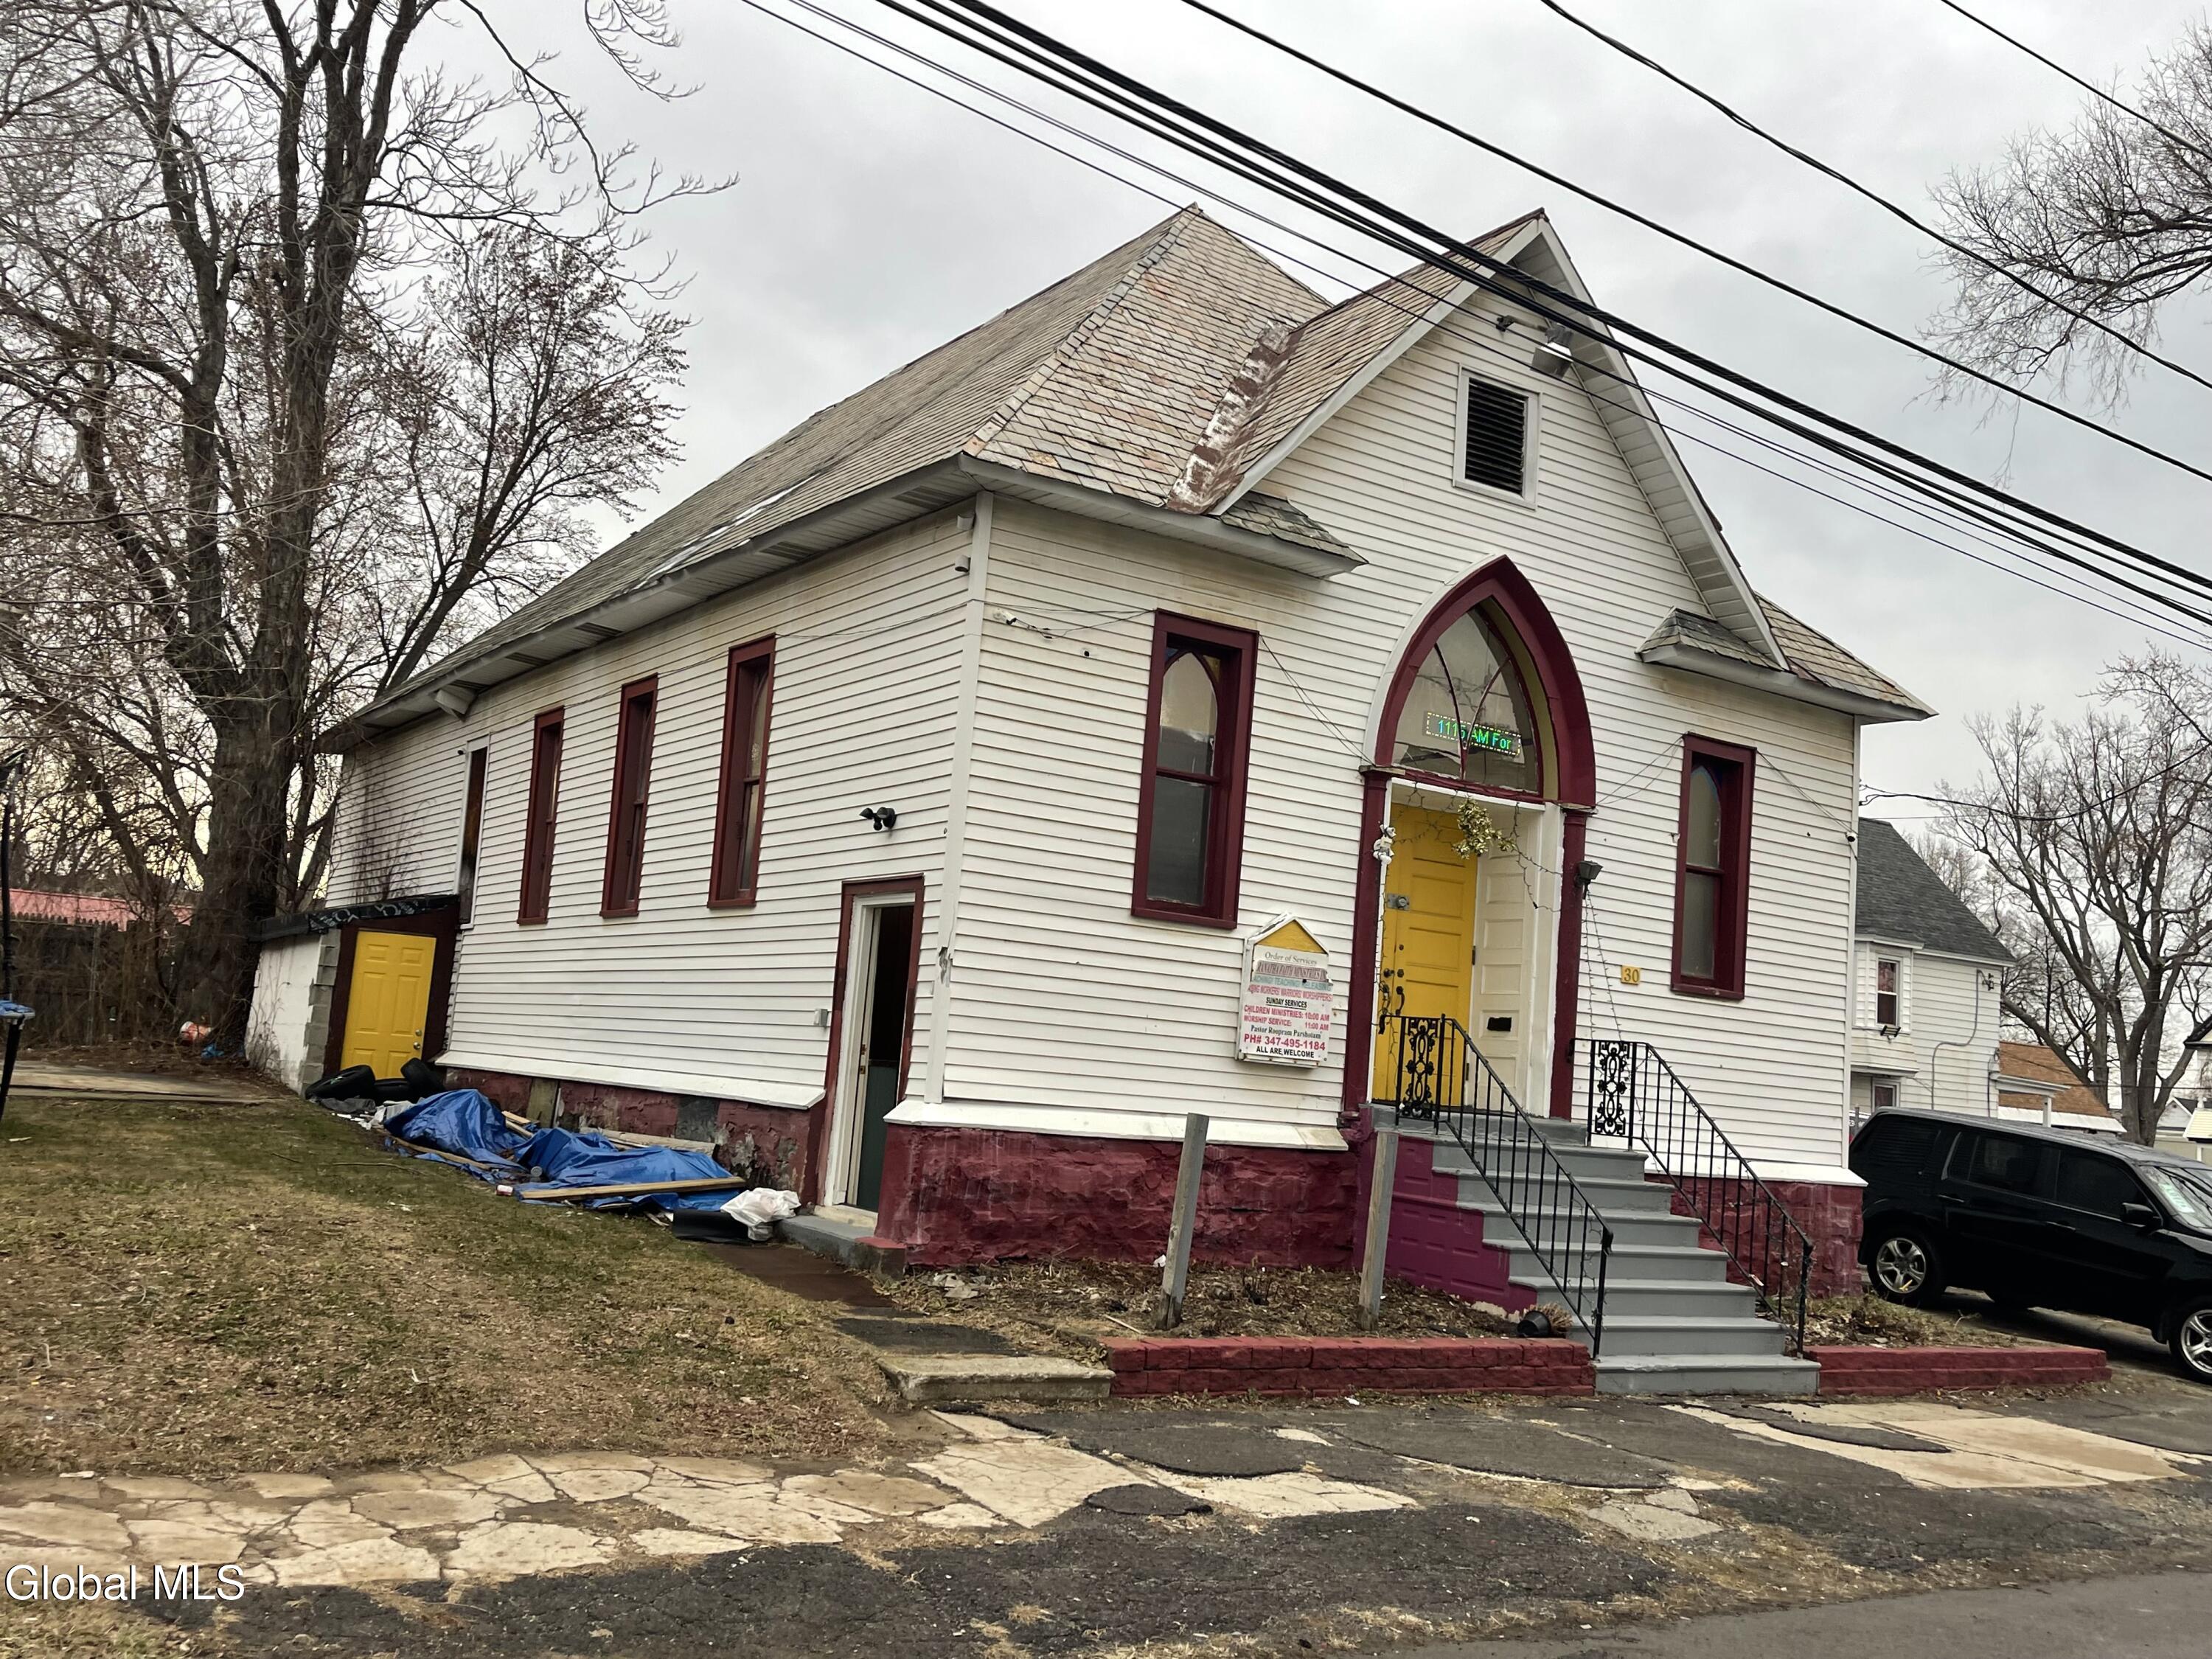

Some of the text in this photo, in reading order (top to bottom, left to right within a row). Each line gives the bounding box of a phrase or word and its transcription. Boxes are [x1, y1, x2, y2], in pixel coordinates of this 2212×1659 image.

[1471, 726, 1489, 745] AM
[1492, 732, 1512, 750] For
[1265, 951, 1283, 960] Order
[1293, 956, 1317, 965] Services
[1624, 968, 1639, 983] 30
[1266, 997, 1307, 1008] SUNDAY SERVICES
[1244, 1005, 1270, 1015] CHILDREN
[1272, 1008, 1303, 1018] MINISTRIES:
[1305, 1012, 1318, 1020] 10:00
[1244, 1015, 1267, 1023] WORSHIP
[1268, 1018, 1292, 1026] SERVICE:
[1251, 1025, 1267, 1033] Pastor
[1268, 1027, 1292, 1036] Roopram
[1244, 1034, 1325, 1051] PH# 347-495-1184
[1256, 1046, 1267, 1054] ALL
[1284, 1049, 1315, 1058] WELCOME
